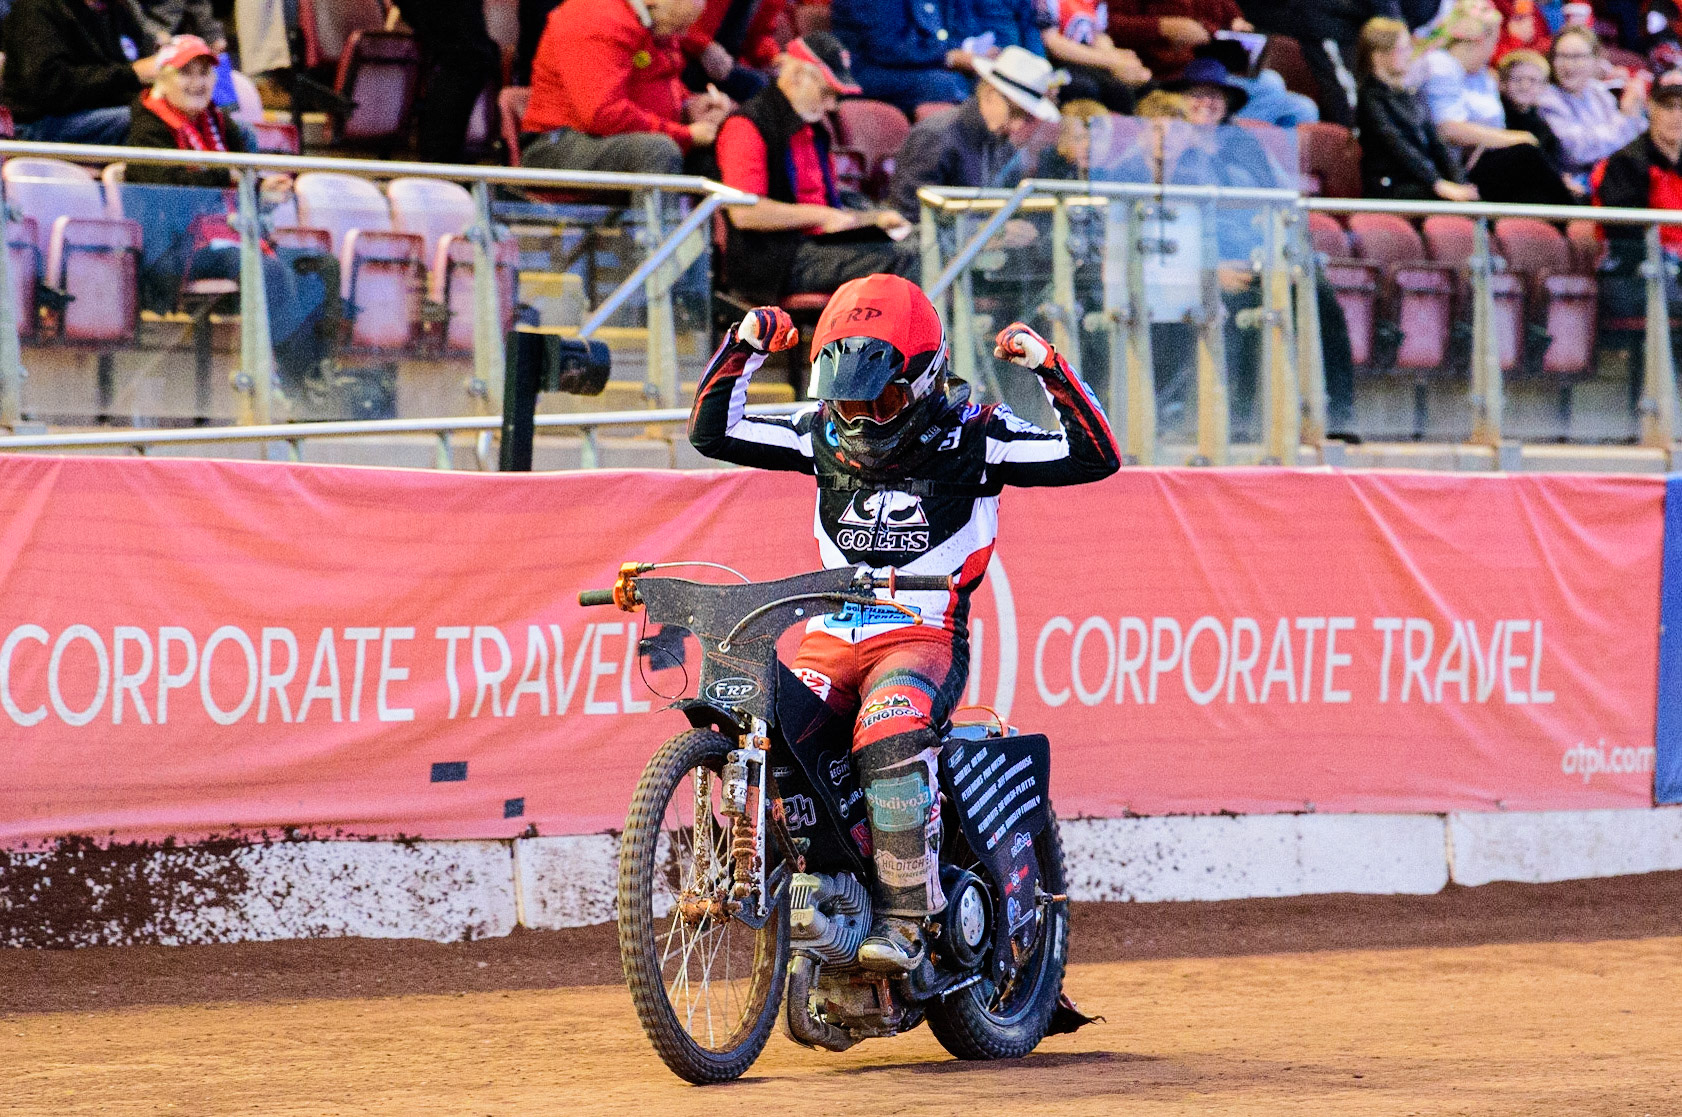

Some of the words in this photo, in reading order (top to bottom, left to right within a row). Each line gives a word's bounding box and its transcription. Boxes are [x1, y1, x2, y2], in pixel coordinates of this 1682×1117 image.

[837, 529, 929, 551] COLTS
[0, 623, 416, 726] CORPORATE
[435, 621, 651, 719] TRAVEL
[1033, 616, 1355, 707] CORPORATE
[1373, 617, 1555, 704] TRAVEL
[715, 683, 753, 698] FRP
[1562, 738, 1656, 784] atpi.com
